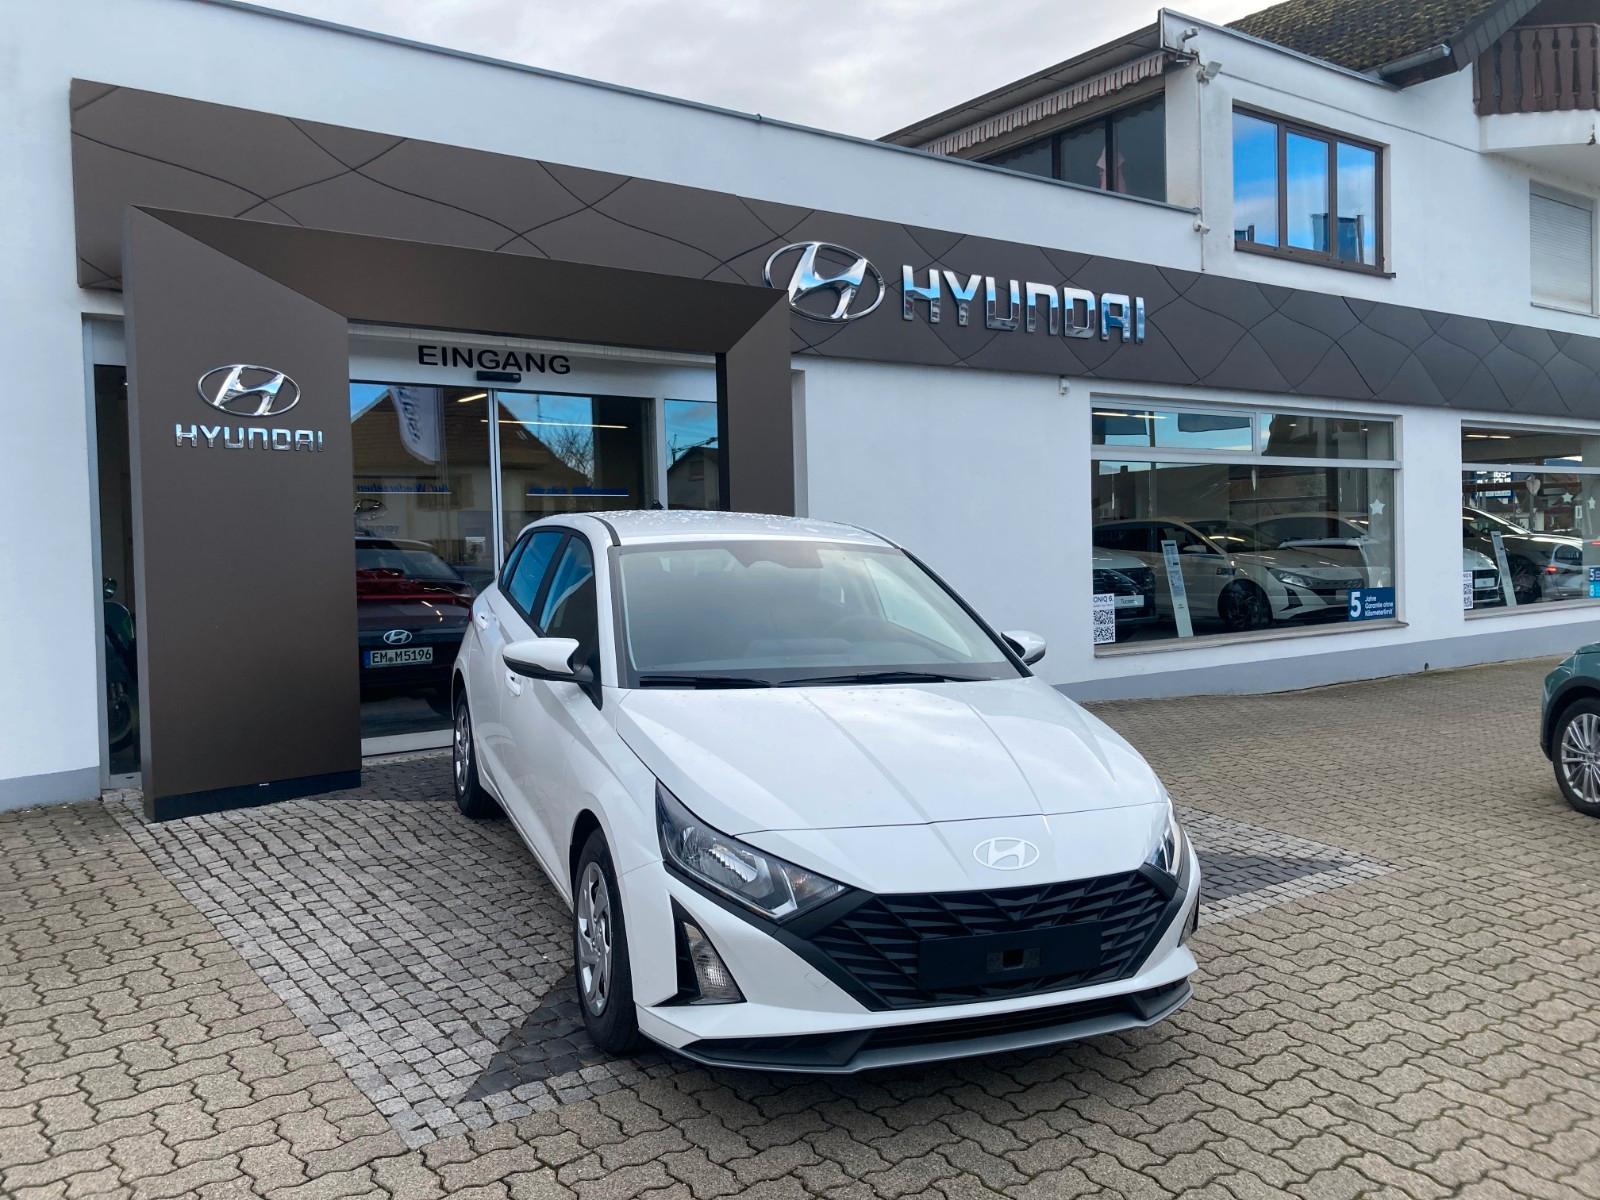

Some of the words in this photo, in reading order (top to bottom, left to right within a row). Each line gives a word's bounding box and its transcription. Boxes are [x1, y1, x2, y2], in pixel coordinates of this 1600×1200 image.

[902, 264, 1145, 344] HYUNDAI
[418, 345, 571, 375] EINGANG
[175, 423, 324, 452] HYUNDAI
[1350, 592, 1361, 617] 5
[372, 652, 388, 664] EM
